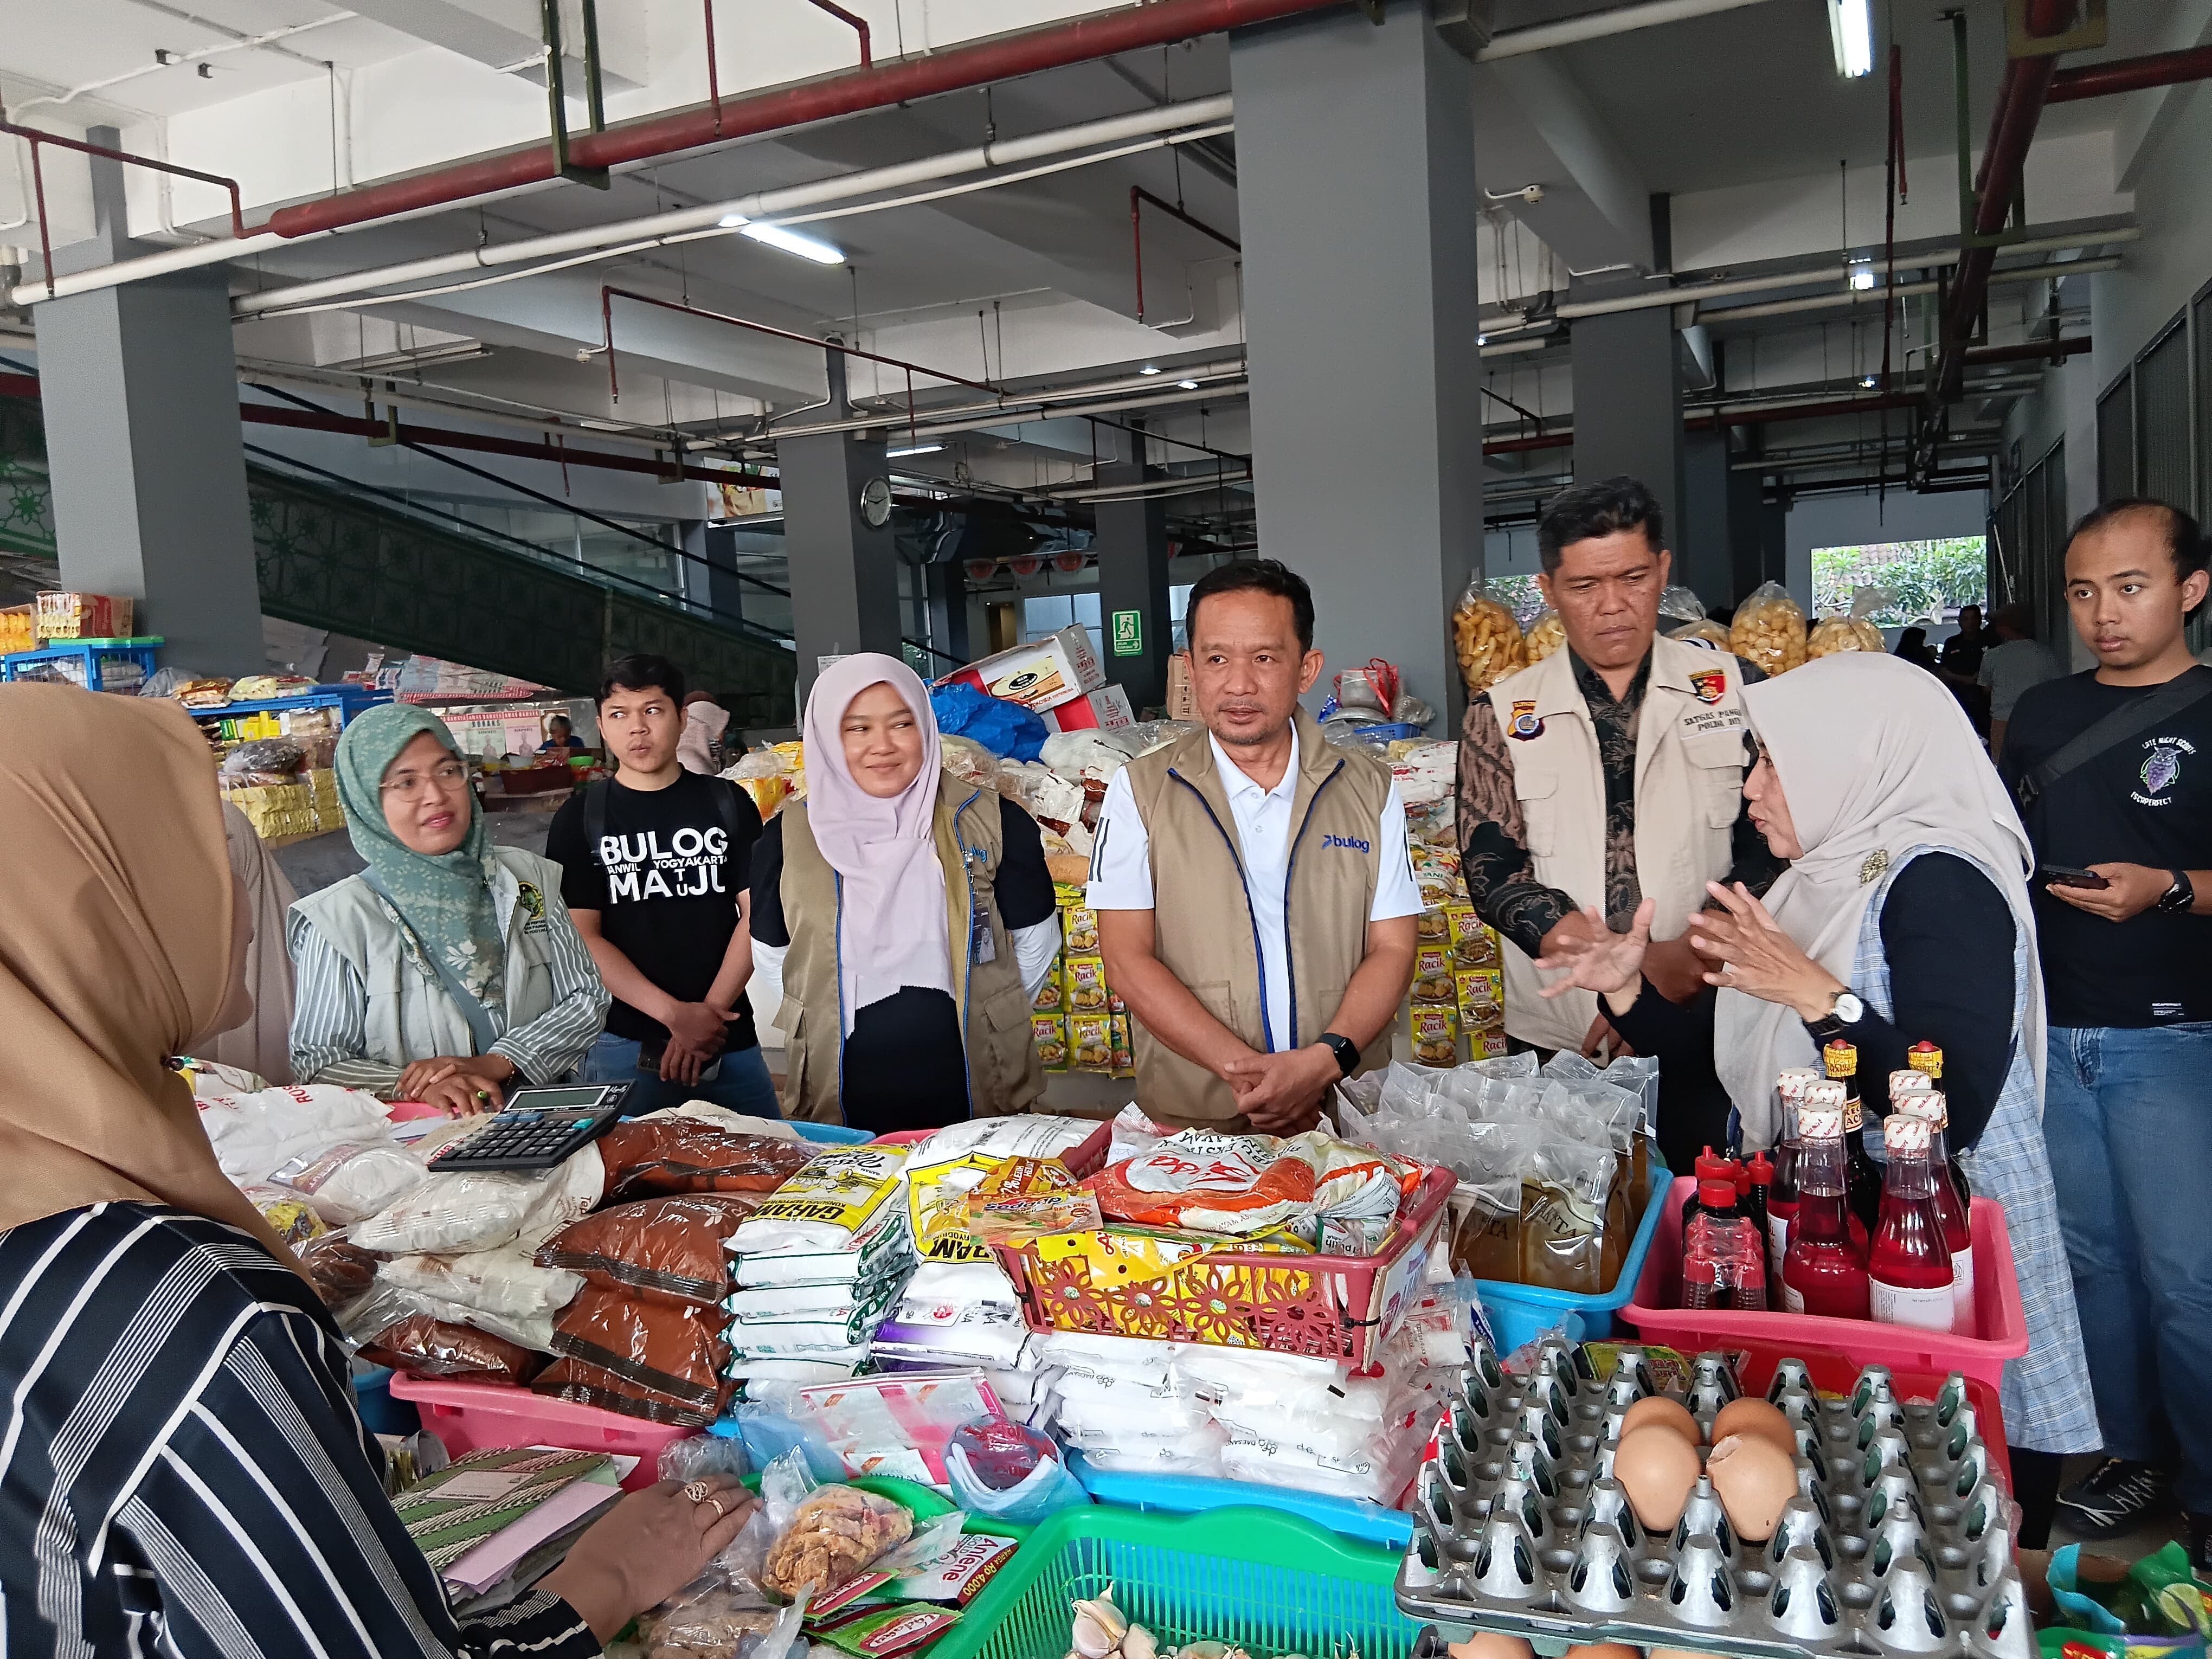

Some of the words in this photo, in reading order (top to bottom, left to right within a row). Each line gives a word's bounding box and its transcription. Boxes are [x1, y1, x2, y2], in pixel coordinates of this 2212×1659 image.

[600, 826, 728, 866] BULOG
[1333, 834, 1371, 855] bulog
[1072, 911, 1094, 924] Racik
[1419, 957, 1445, 972] Racik
[1075, 969, 1097, 982] Racik
[1467, 981, 1493, 995] Racik
[1033, 1023, 1057, 1036] Racik
[1419, 1020, 1448, 1033] Racik
[1483, 1038, 1507, 1051] Raci
[806, 1200, 846, 1208] KONSUMSI
[984, 1195, 1063, 1211] Sedaap
[751, 1202, 846, 1221] GARAM
[942, 1538, 999, 1582] Anlene
[993, 1546, 1012, 1565] HARGA
[983, 1561, 998, 1576] Rp
